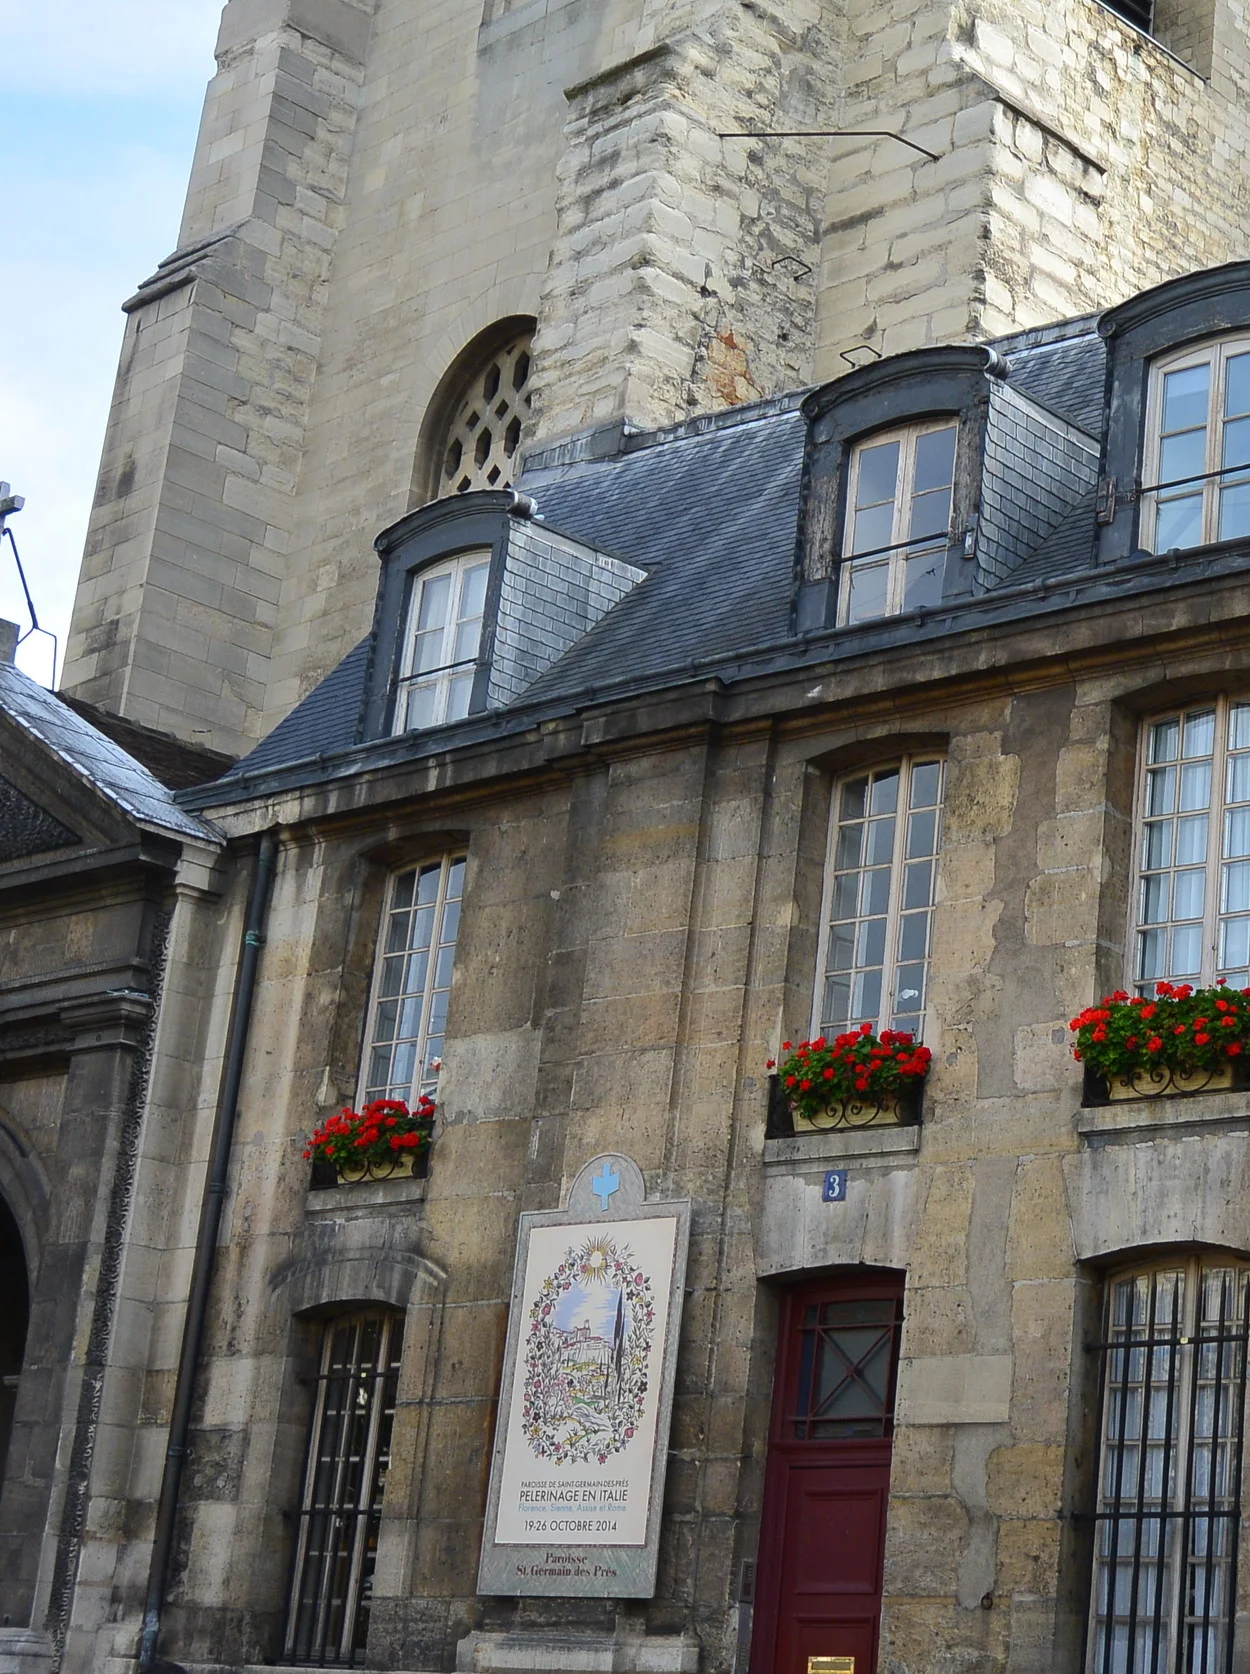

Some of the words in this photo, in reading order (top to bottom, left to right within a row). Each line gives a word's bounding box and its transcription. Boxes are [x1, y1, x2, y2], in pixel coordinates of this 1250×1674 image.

[828, 1174, 840, 1198] 3
[520, 1480, 547, 1488] PAROISSE
[548, 1480, 556, 1488] DE
[519, 1490, 579, 1502] PELERINAGE
[582, 1490, 597, 1502] EN
[599, 1489, 628, 1502] ITALIE
[576, 1503, 597, 1512] Assise
[599, 1503, 606, 1512] et
[607, 1503, 627, 1512] Rome
[524, 1520, 547, 1532] 19-26
[549, 1520, 593, 1532] OCTOBRE
[595, 1520, 617, 1532] 2014
[545, 1552, 588, 1564] Paroisse
[574, 1565, 591, 1576] des
[593, 1565, 618, 1577] Prés
